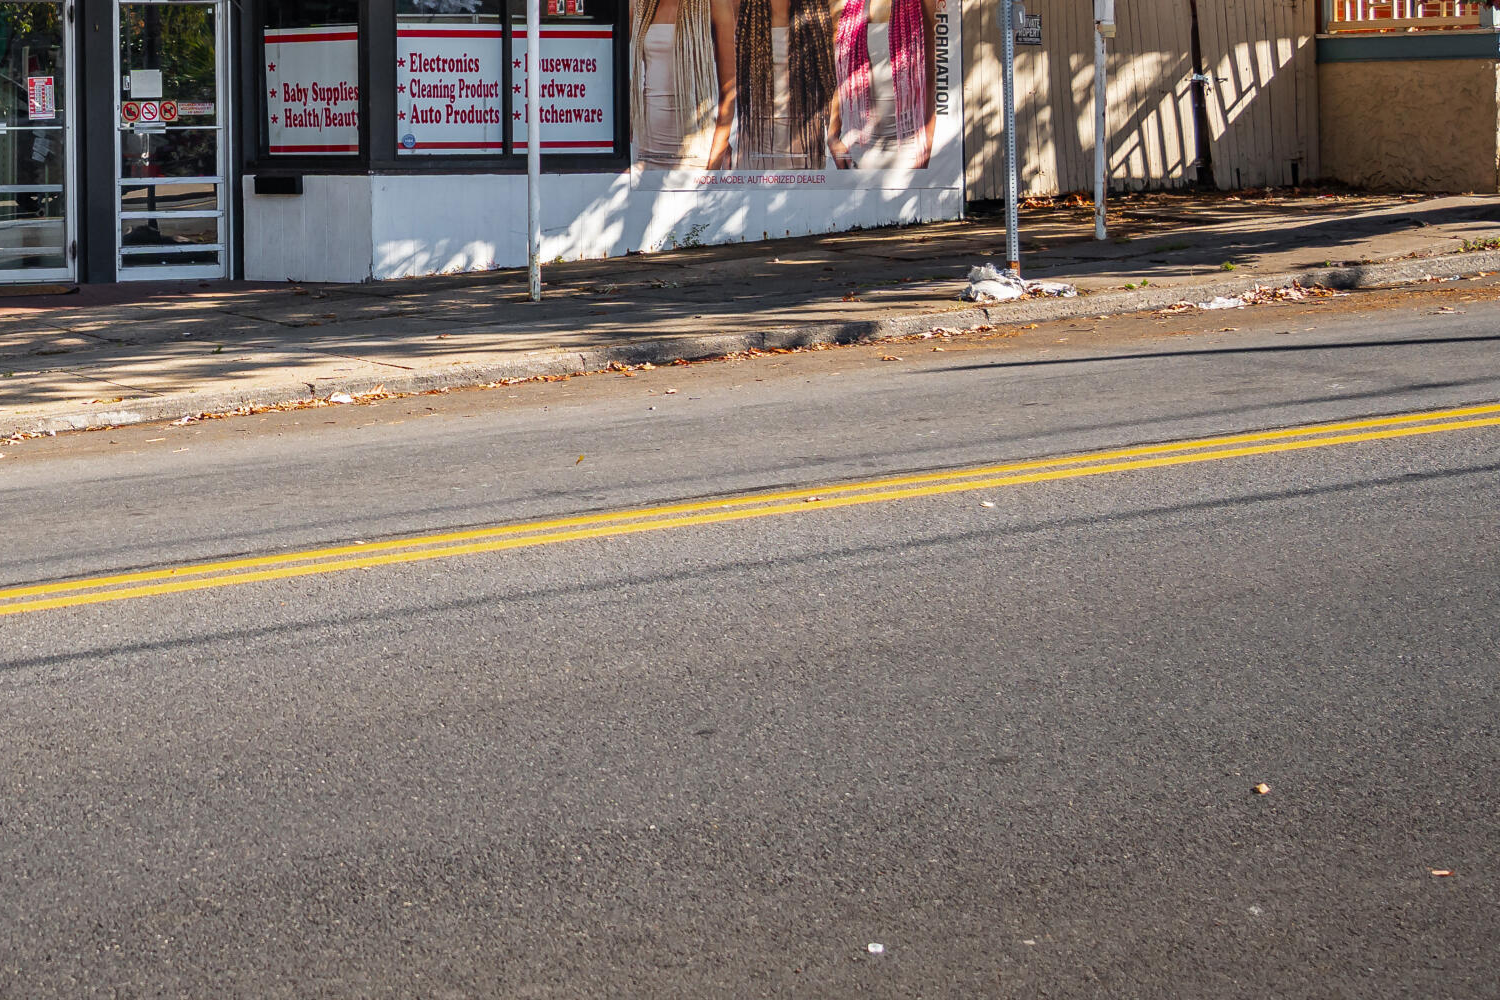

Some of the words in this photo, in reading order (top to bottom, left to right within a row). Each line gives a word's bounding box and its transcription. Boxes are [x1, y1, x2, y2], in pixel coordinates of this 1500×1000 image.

[409, 53, 480, 72] Electronics
[524, 52, 597, 73] usewares
[935, 13, 949, 116] FORMATION
[282, 82, 309, 107] Baby
[311, 81, 359, 106] Supplies
[409, 78, 456, 103] Cleaning
[458, 78, 499, 98] Product
[524, 78, 586, 98] rdware
[410, 103, 442, 124] Auto
[445, 103, 500, 124] Products
[524, 103, 603, 124] tchenware
[747, 174, 796, 184] AUTHORIZED
[796, 174, 826, 184] DEALER
